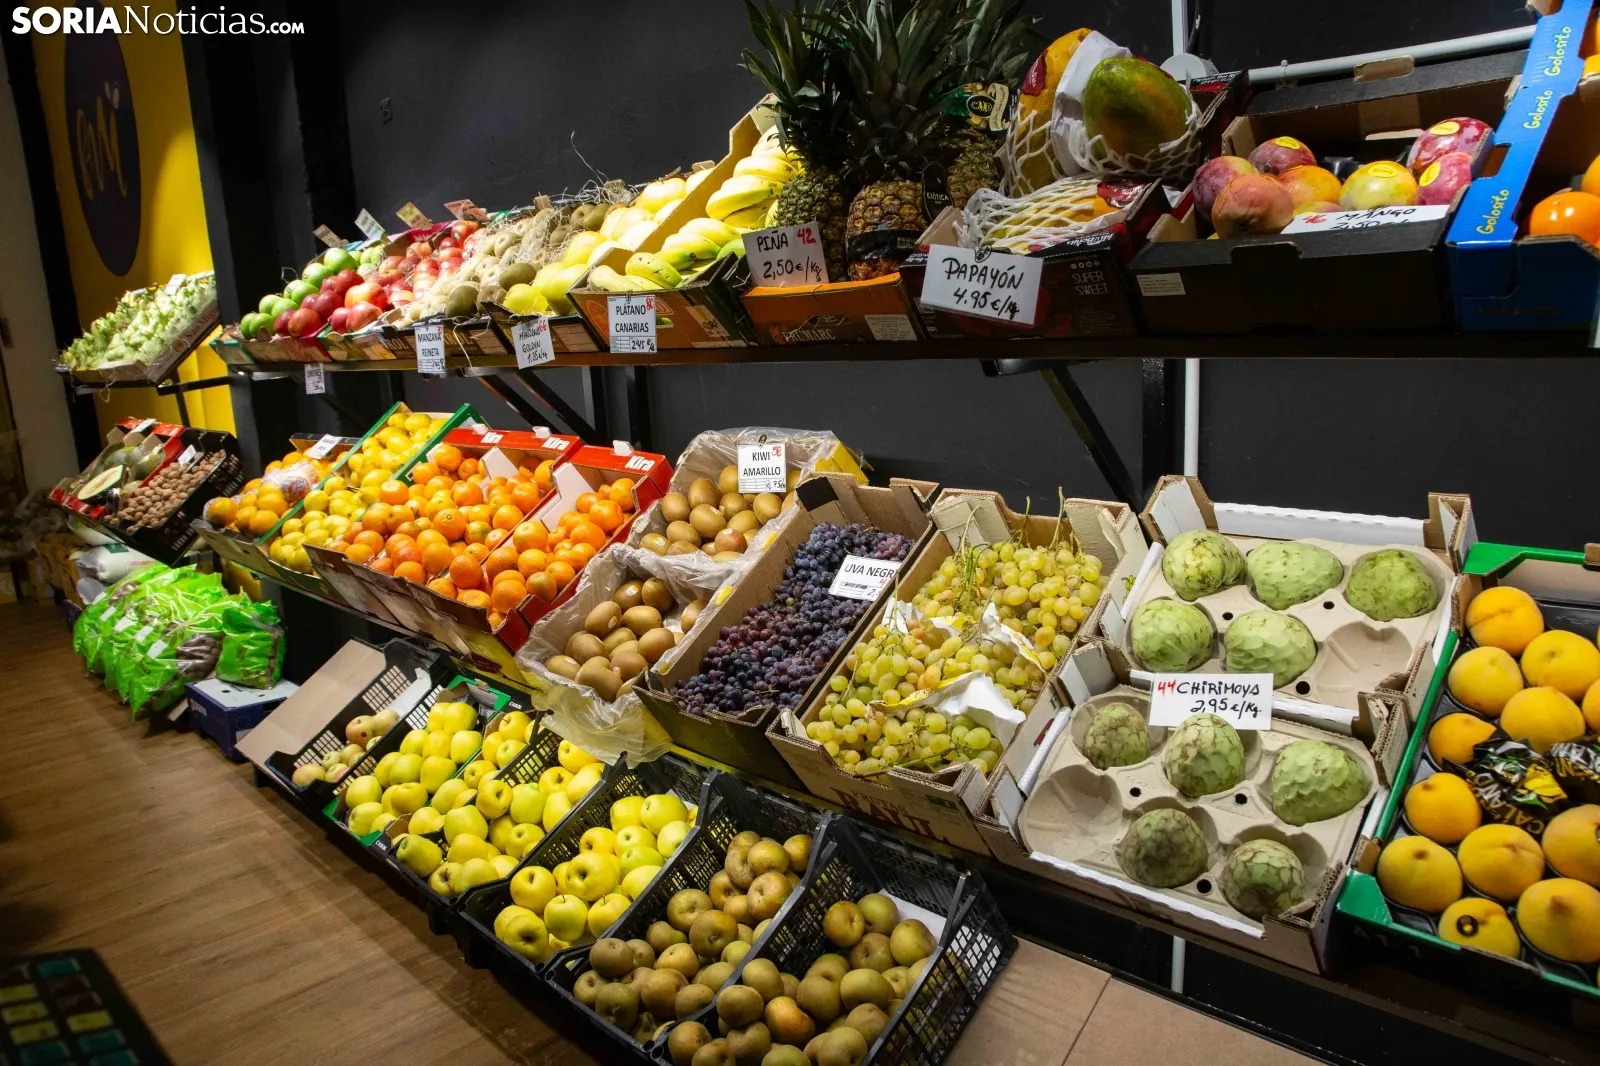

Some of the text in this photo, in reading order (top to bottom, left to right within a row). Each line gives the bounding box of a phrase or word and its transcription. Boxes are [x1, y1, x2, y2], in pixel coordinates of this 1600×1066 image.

[1543, 26, 1572, 77] Golosito
[1523, 90, 1553, 129] Golosito
[1335, 208, 1417, 221] MANGO
[1476, 188, 1510, 235] Golosito
[756, 230, 789, 252] PIÑA
[797, 227, 817, 244] 42
[942, 257, 1024, 290] PAPAYÓN
[1072, 270, 1105, 284] SUPER
[1075, 283, 1109, 297] SWEET
[615, 303, 646, 316] PLÁTANO
[615, 322, 650, 333] CANARIAS
[417, 333, 442, 343] MANZANA
[421, 347, 440, 357] REINETA
[522, 340, 541, 354] GOLDEN
[481, 431, 504, 444] Kira
[542, 437, 570, 450] Kira
[624, 455, 655, 471] Kira
[752, 451, 771, 461] KIWI
[743, 466, 781, 477] AMARILLO
[844, 564, 896, 579] UVA NEGR
[1157, 680, 1176, 696] 44
